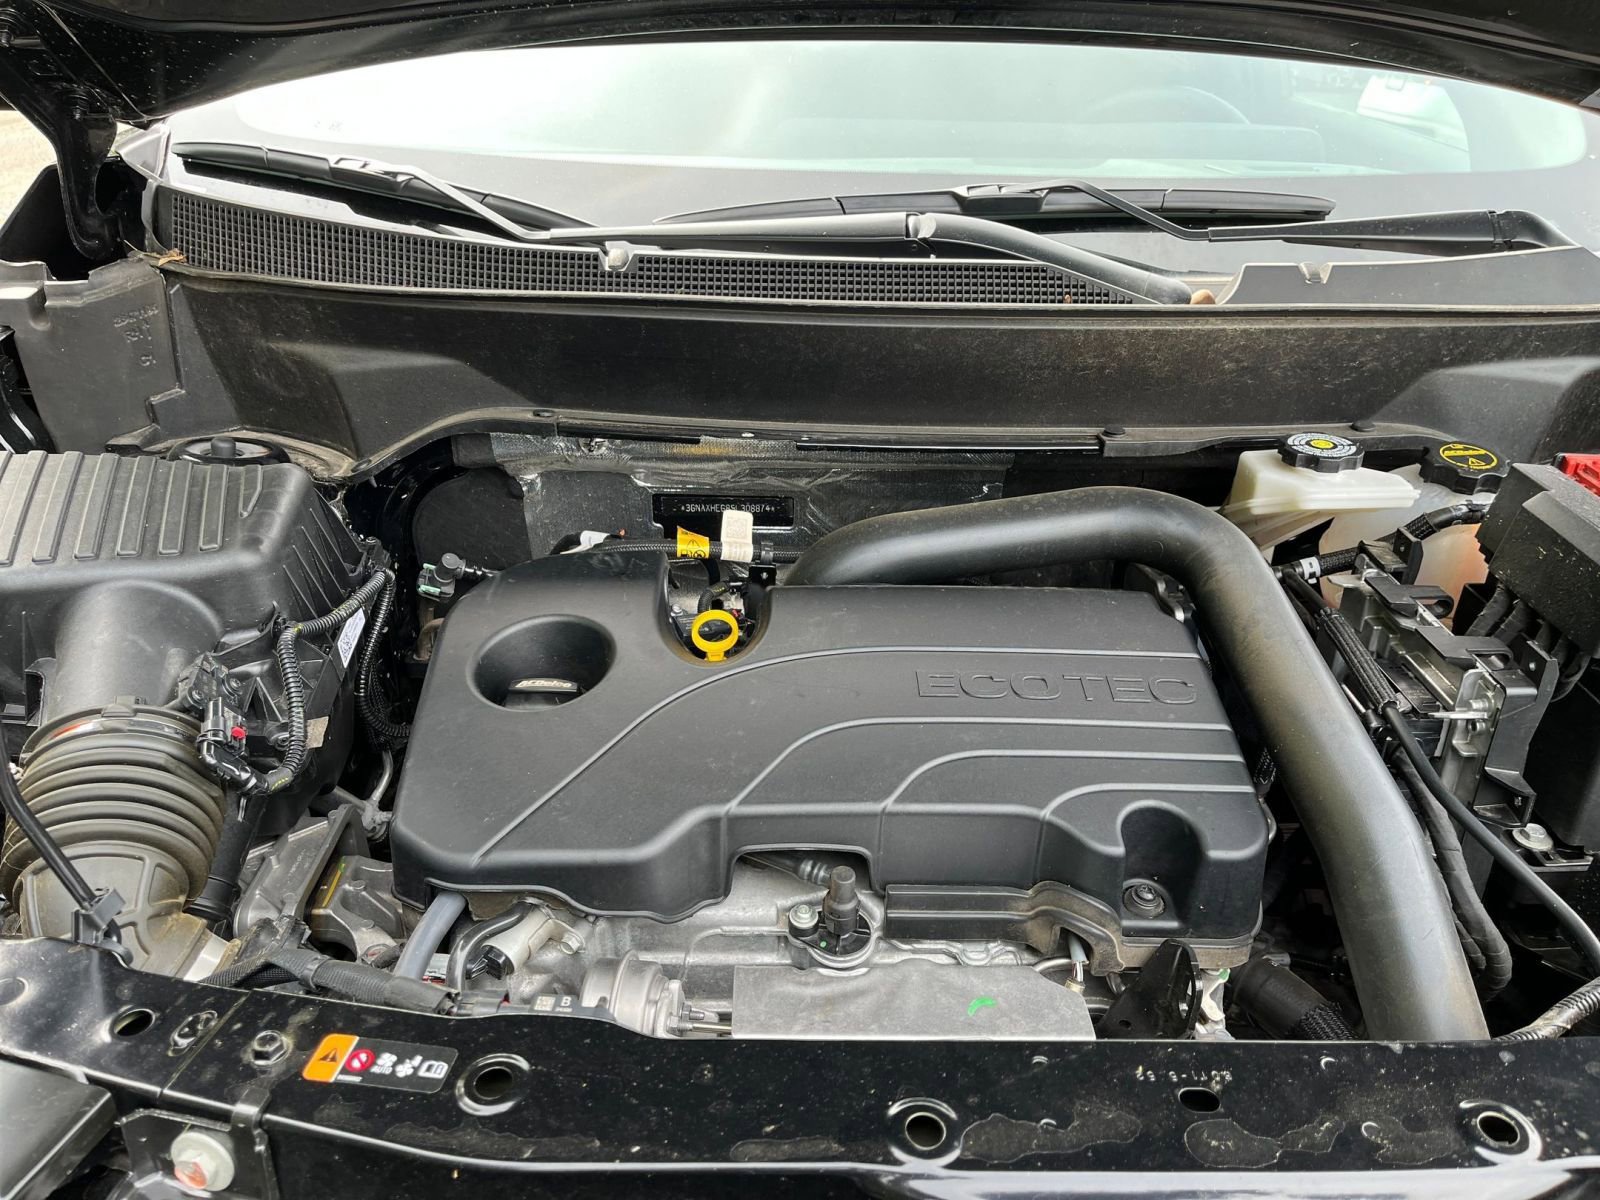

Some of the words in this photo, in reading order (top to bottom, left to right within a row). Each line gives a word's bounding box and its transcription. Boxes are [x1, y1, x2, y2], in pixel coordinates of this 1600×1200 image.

[915, 670, 1198, 705] ECOTEC
[560, 996, 572, 1007] B
[369, 1064, 393, 1075] AUTO
